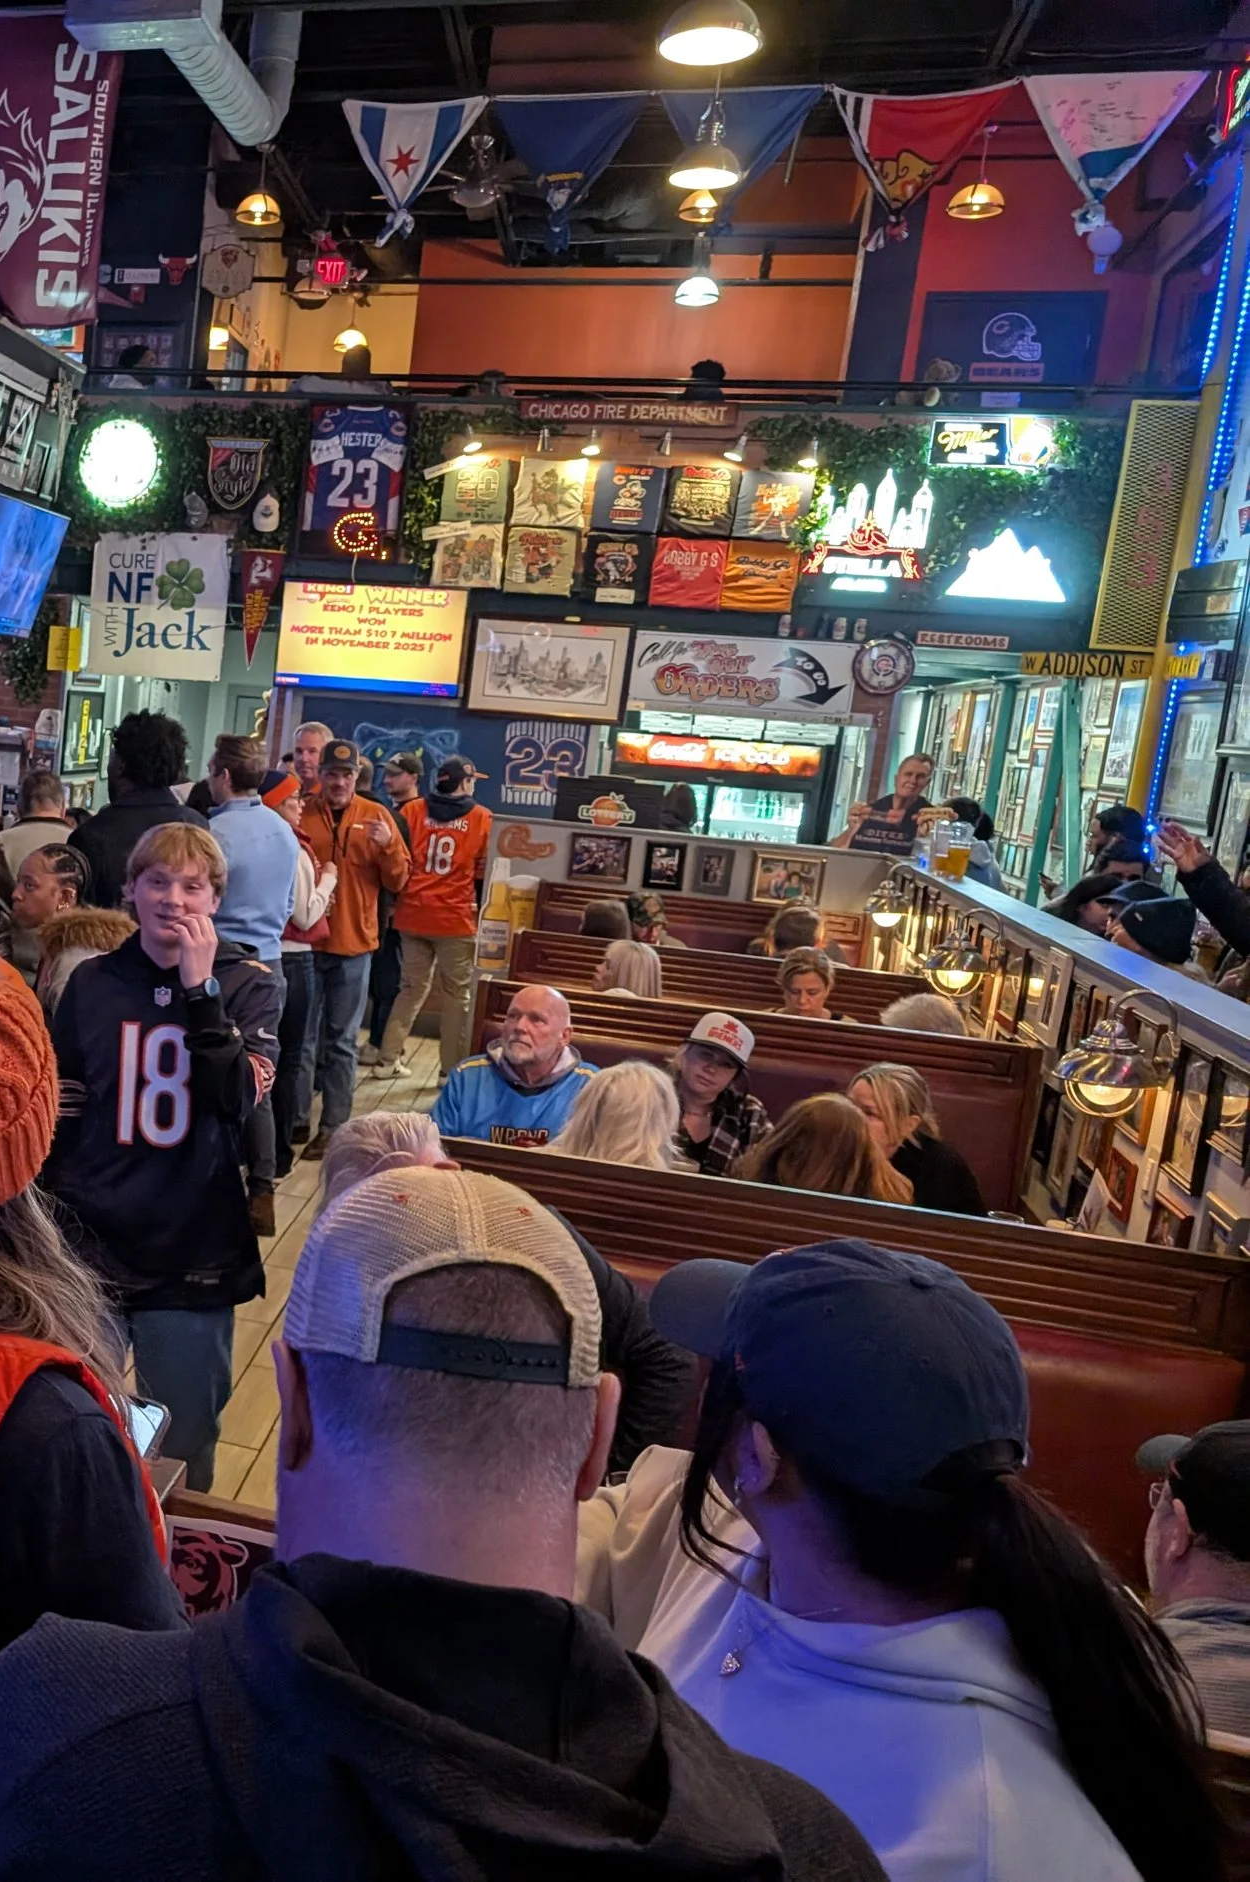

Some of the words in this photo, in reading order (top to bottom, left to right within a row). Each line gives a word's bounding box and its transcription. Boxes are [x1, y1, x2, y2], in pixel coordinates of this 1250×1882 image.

[88, 79, 110, 186] SOUTHERN
[36, 42, 98, 307] SALUKIS
[317, 261, 345, 281] EXIT
[972, 367, 1041, 377] BEARS
[528, 403, 590, 418] CHICAGO
[593, 404, 627, 420] FIRE
[630, 405, 728, 421] DEPARTMENT
[341, 431, 382, 448] HESTER
[937, 428, 999, 452] Miller
[230, 452, 256, 473] Old
[213, 456, 251, 500] Style
[326, 459, 379, 509] 23
[455, 469, 500, 500] 20
[109, 553, 154, 569] CURE
[663, 550, 696, 566] BOBBY
[821, 555, 902, 577] STELLA
[107, 571, 154, 603] NF
[365, 587, 450, 607] WINNER
[322, 604, 355, 613] KENO
[368, 606, 424, 617] PLAYERS
[103, 606, 119, 646] WITH
[357, 617, 386, 625] WON
[112, 607, 212, 658] Jack
[290, 624, 325, 634] MORE
[328, 627, 362, 636] THAN
[400, 631, 452, 642] MILLION
[920, 633, 1006, 648] RESTROOMS
[305, 637, 319, 645] IN
[322, 639, 389, 649] NOVEMBER
[394, 641, 425, 651] 2025
[795, 656, 815, 669] TO
[1025, 659, 1035, 670] W
[1039, 653, 1125, 676] ADDISON
[1130, 660, 1145, 673] ST
[812, 672, 827, 687] GO
[505, 735, 584, 792] 23
[714, 747, 744, 763] ICE
[582, 808, 631, 821] LOTTERY
[425, 833, 456, 876] 18
[117, 1021, 192, 1148] 18
